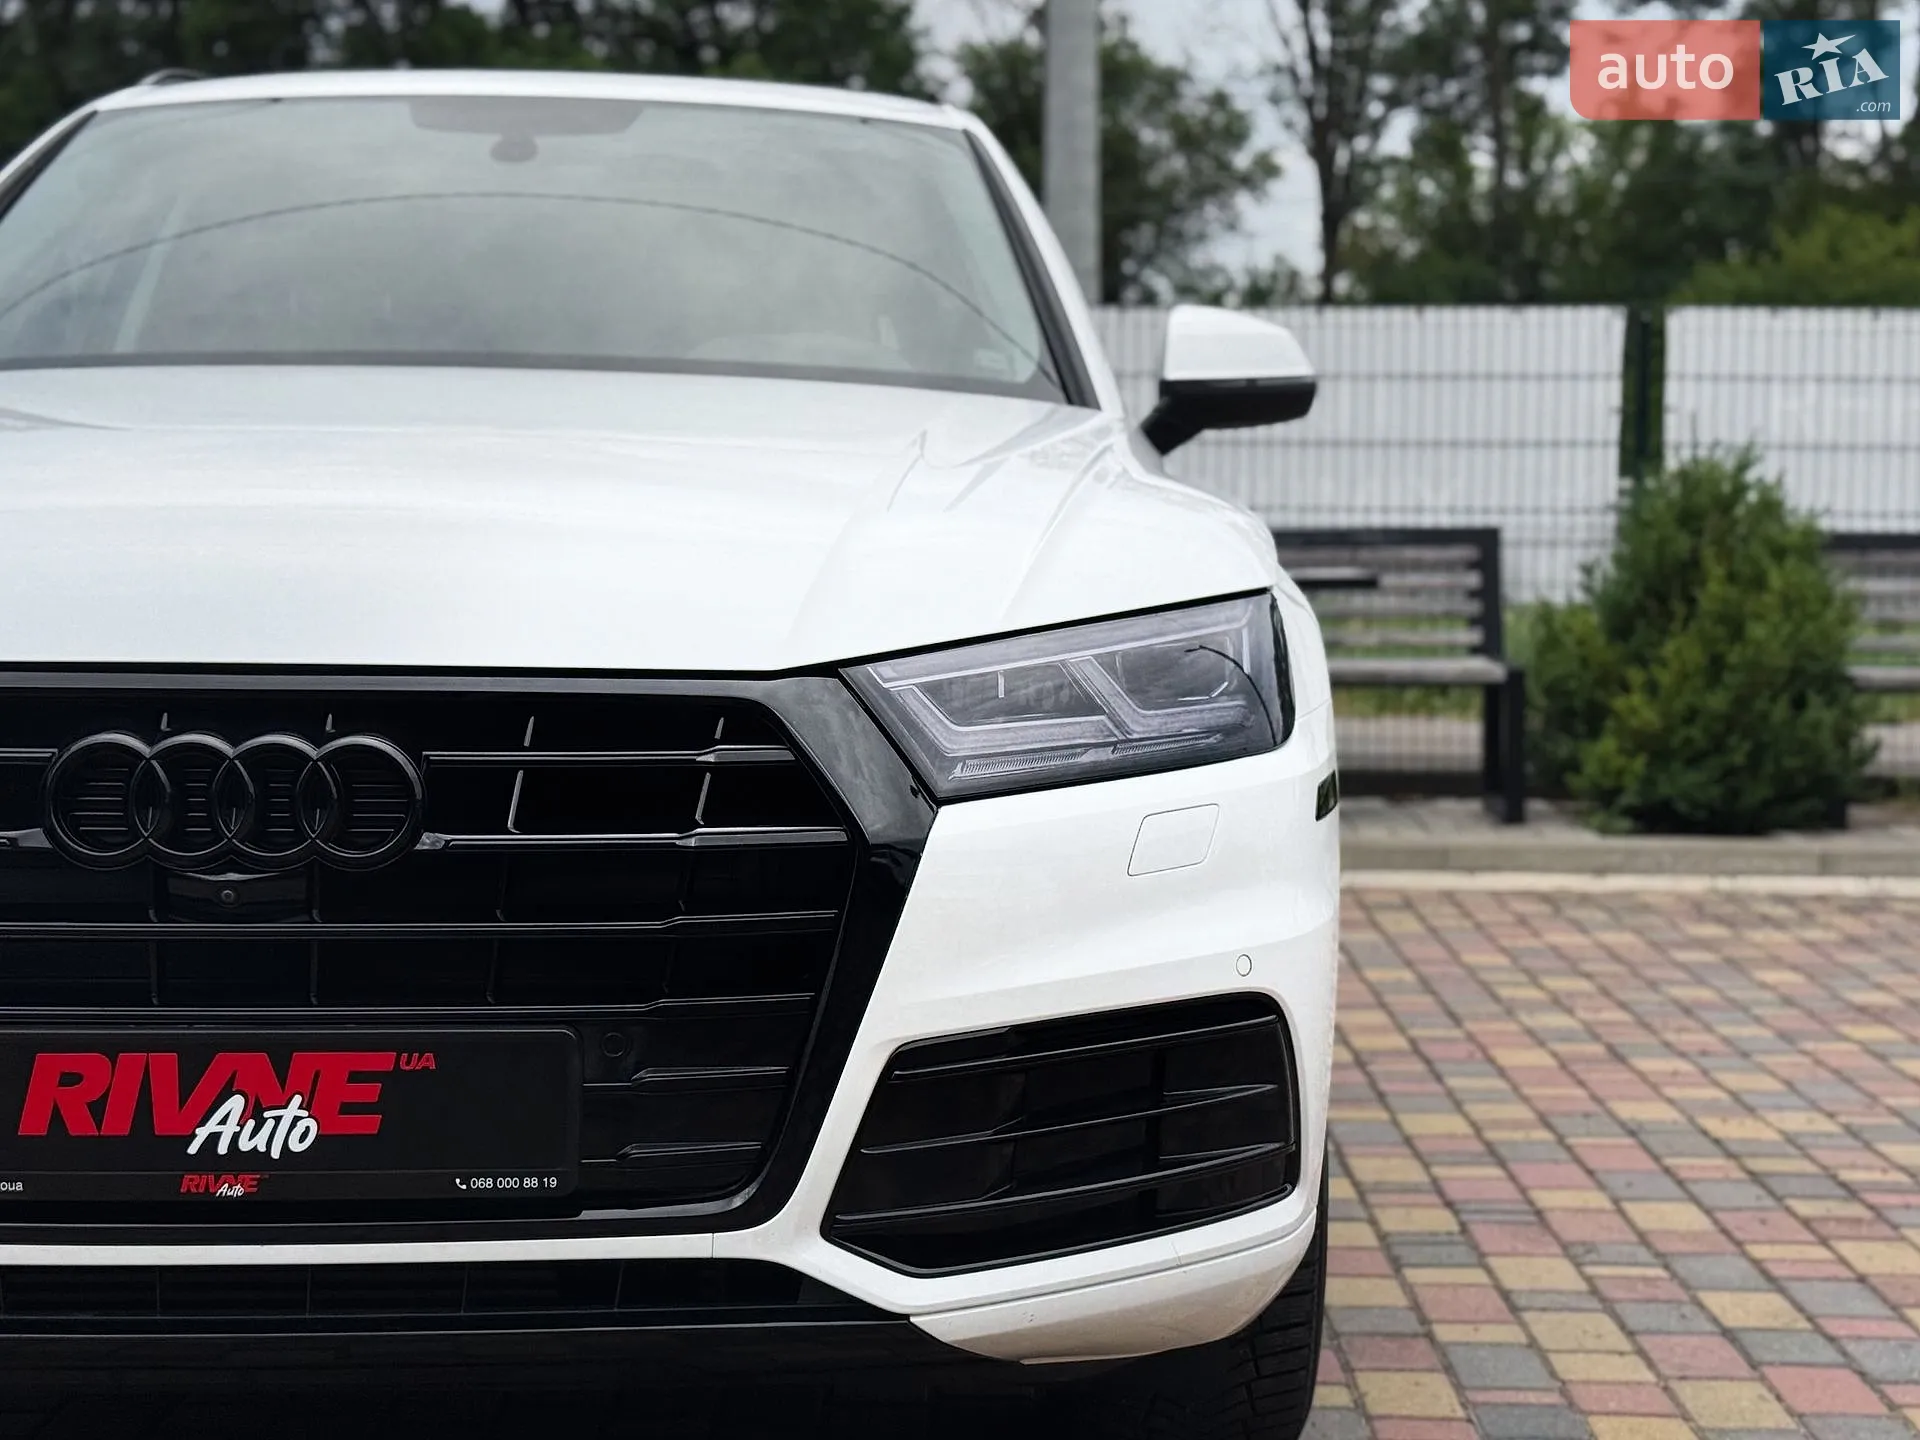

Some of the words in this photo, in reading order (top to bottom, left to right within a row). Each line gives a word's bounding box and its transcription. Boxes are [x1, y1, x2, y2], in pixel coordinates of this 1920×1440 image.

[18, 1052, 397, 1136] RIVNE
[400, 1053, 437, 1070] UA
[187, 1094, 322, 1160] Auto
[180, 1174, 261, 1193] RIVNE
[215, 1182, 245, 1198] Auto
[470, 1177, 494, 1189] 068
[496, 1177, 520, 1189] 000
[523, 1177, 539, 1188] 88
[543, 1176, 558, 1188] 19
